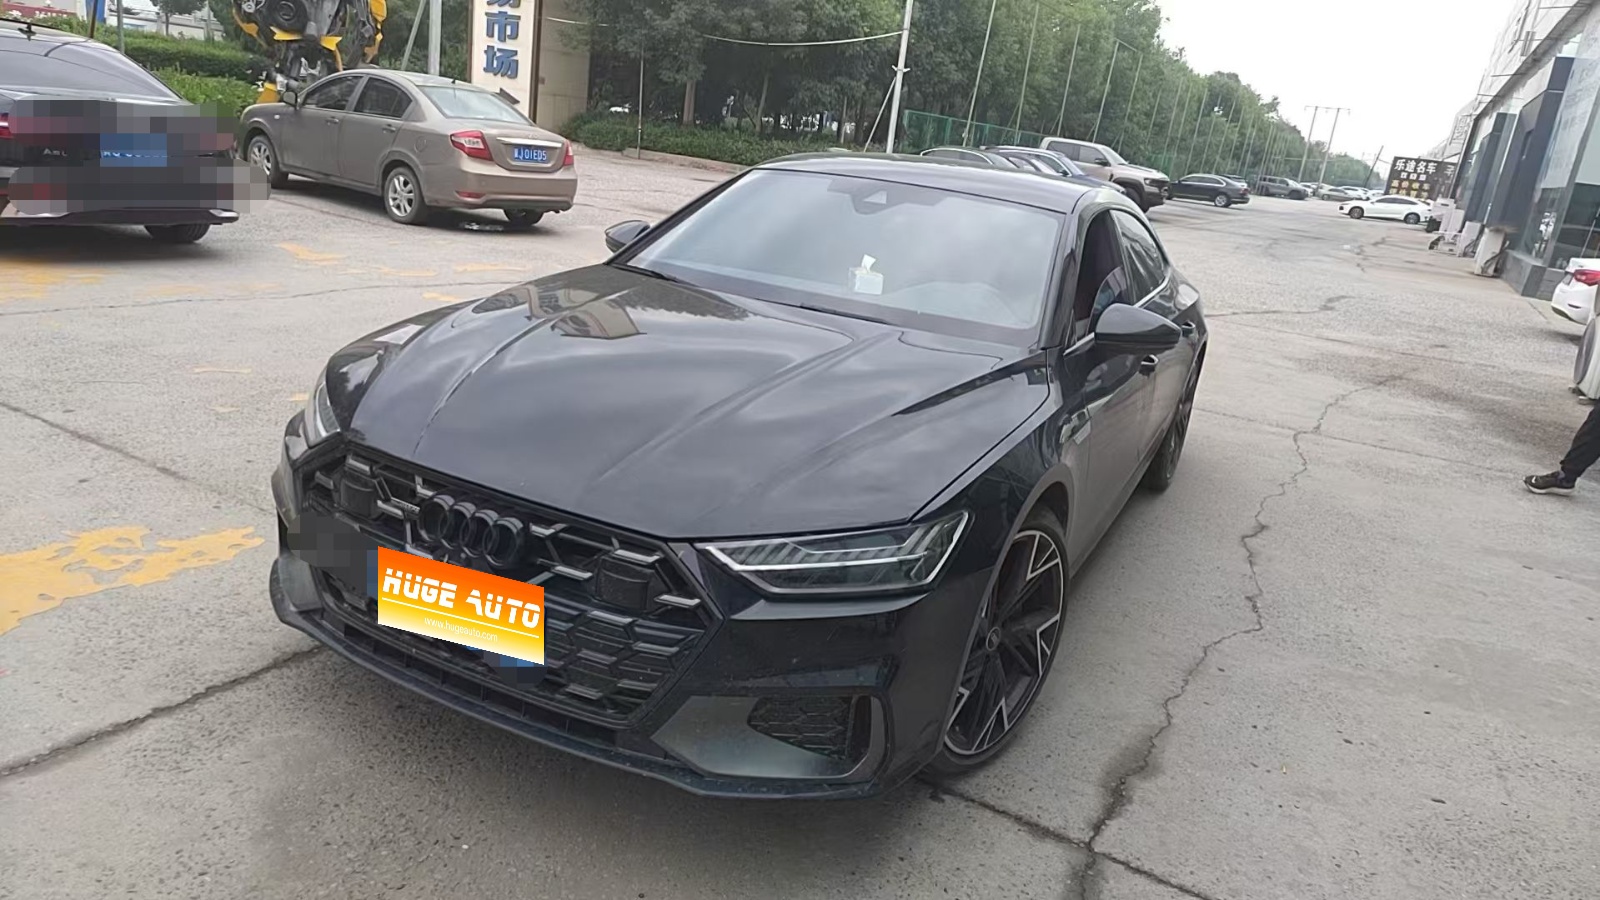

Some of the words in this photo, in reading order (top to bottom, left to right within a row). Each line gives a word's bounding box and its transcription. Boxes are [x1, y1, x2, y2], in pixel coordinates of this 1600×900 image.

[483, 0, 521, 79] 市场
[1394, 159, 1437, 174] 乐途名车
